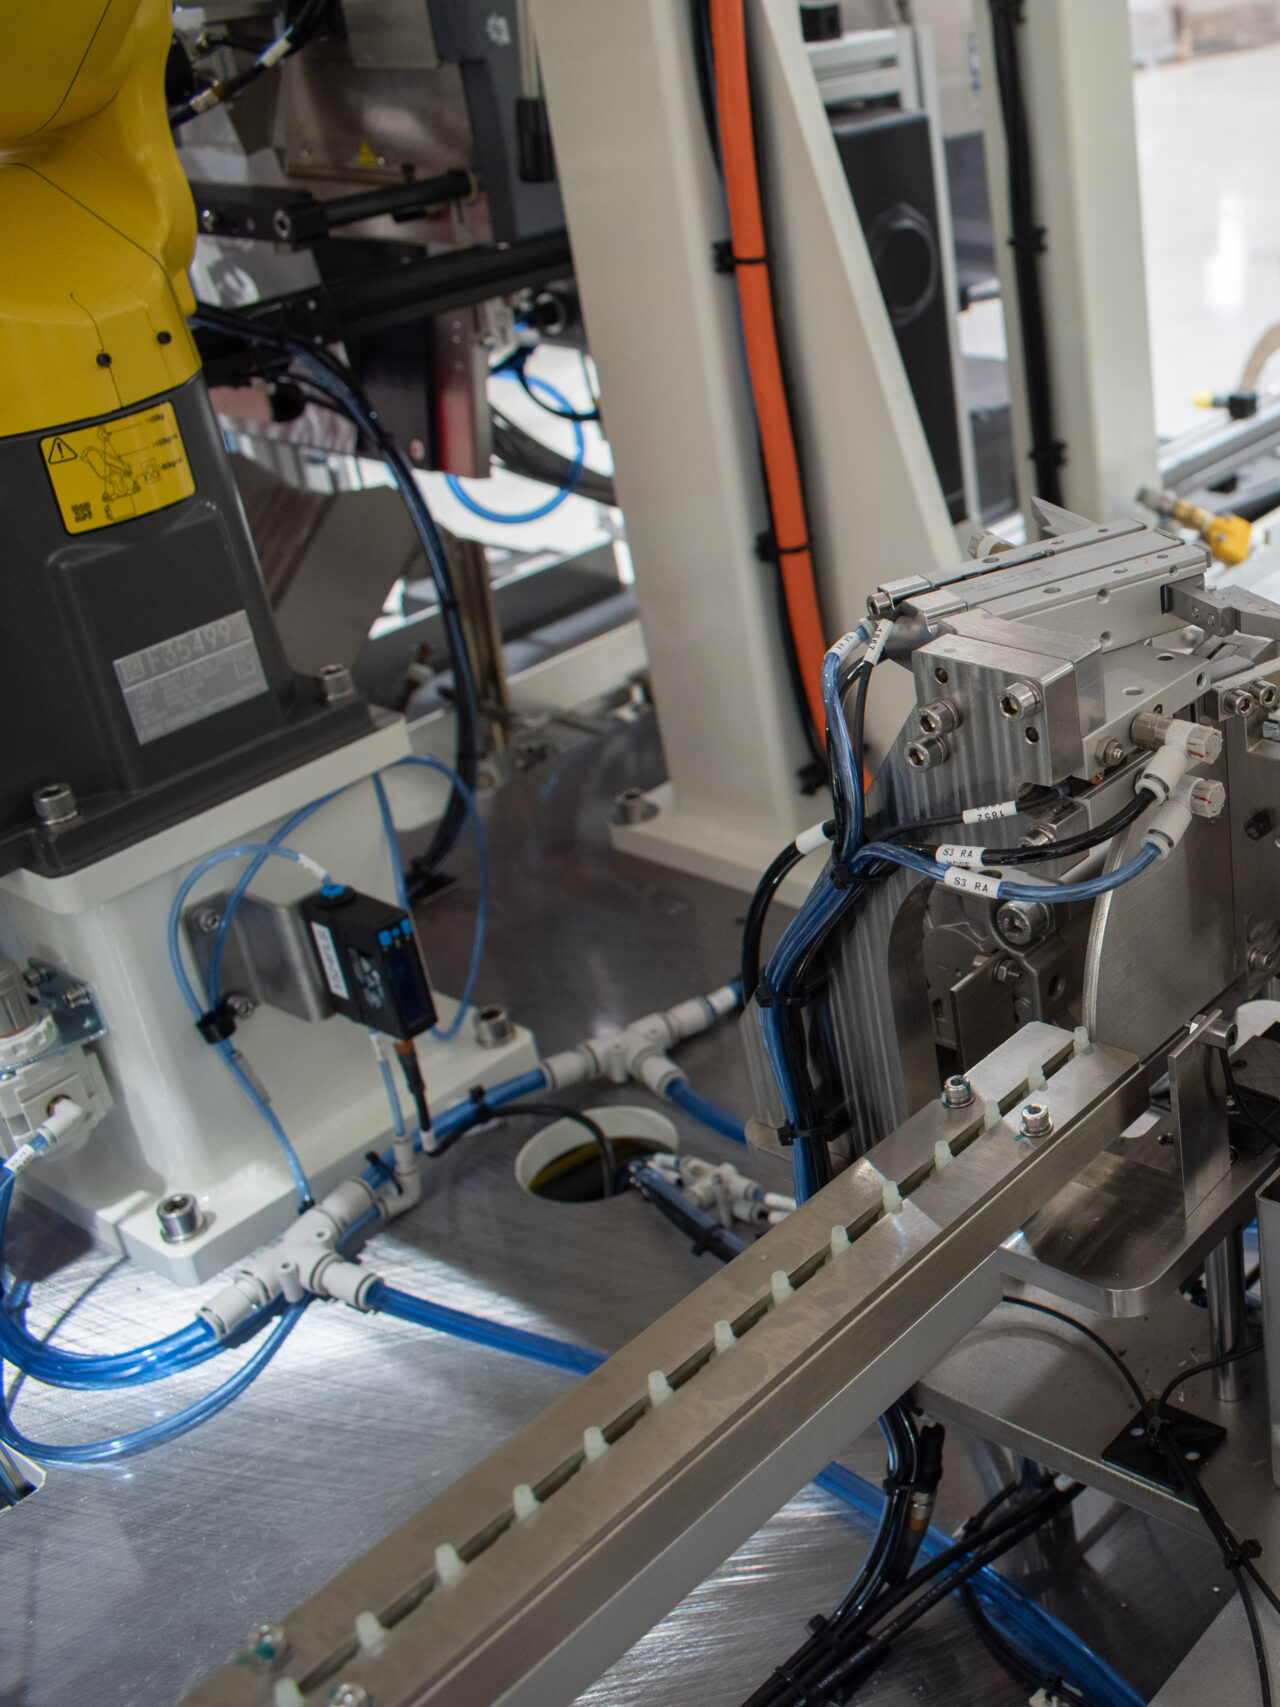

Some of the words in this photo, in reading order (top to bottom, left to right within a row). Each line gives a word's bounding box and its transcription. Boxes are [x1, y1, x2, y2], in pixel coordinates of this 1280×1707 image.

[960, 849, 973, 858] RA
[953, 877, 967, 887] S3
[974, 882, 989, 893] RA
